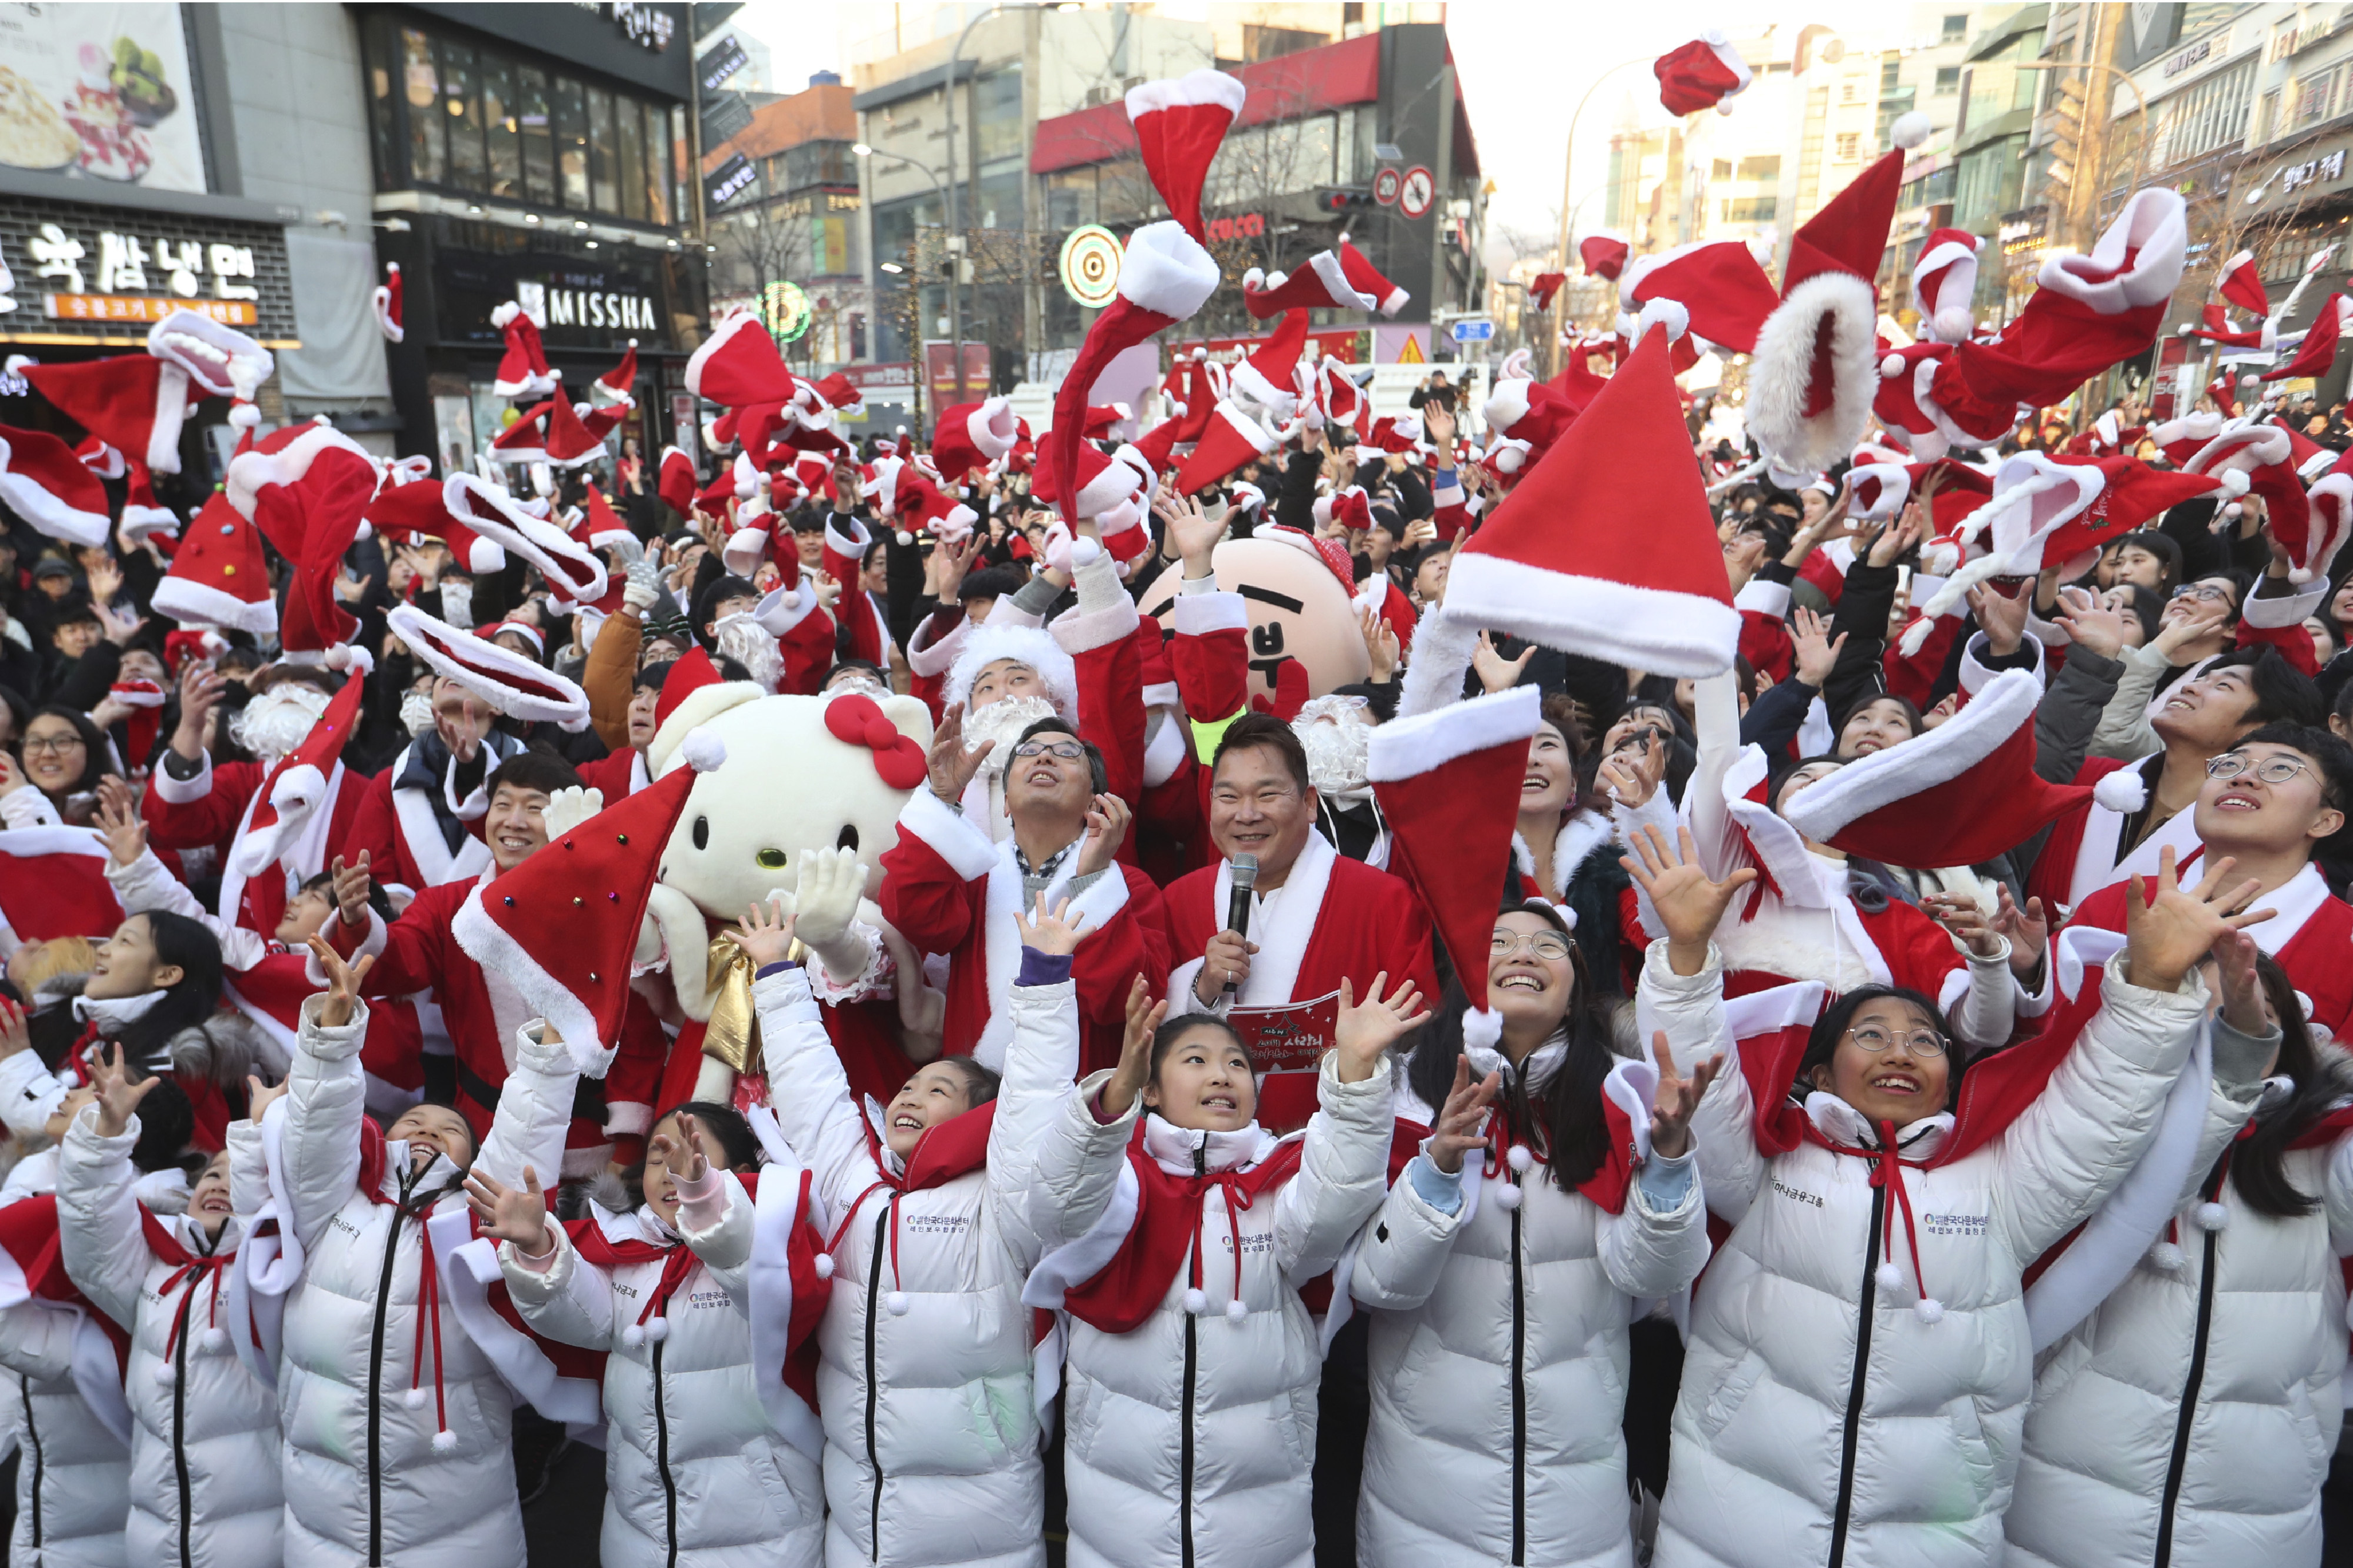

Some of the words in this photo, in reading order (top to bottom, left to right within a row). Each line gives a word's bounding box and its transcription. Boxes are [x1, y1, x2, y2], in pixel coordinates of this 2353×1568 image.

[29, 222, 259, 301] 육쌈냉면
[550, 288, 656, 331] MISSHA
[1284, 1033, 1322, 1046] 사랑의
[1774, 1182, 1823, 1208] 하나금융그룹
